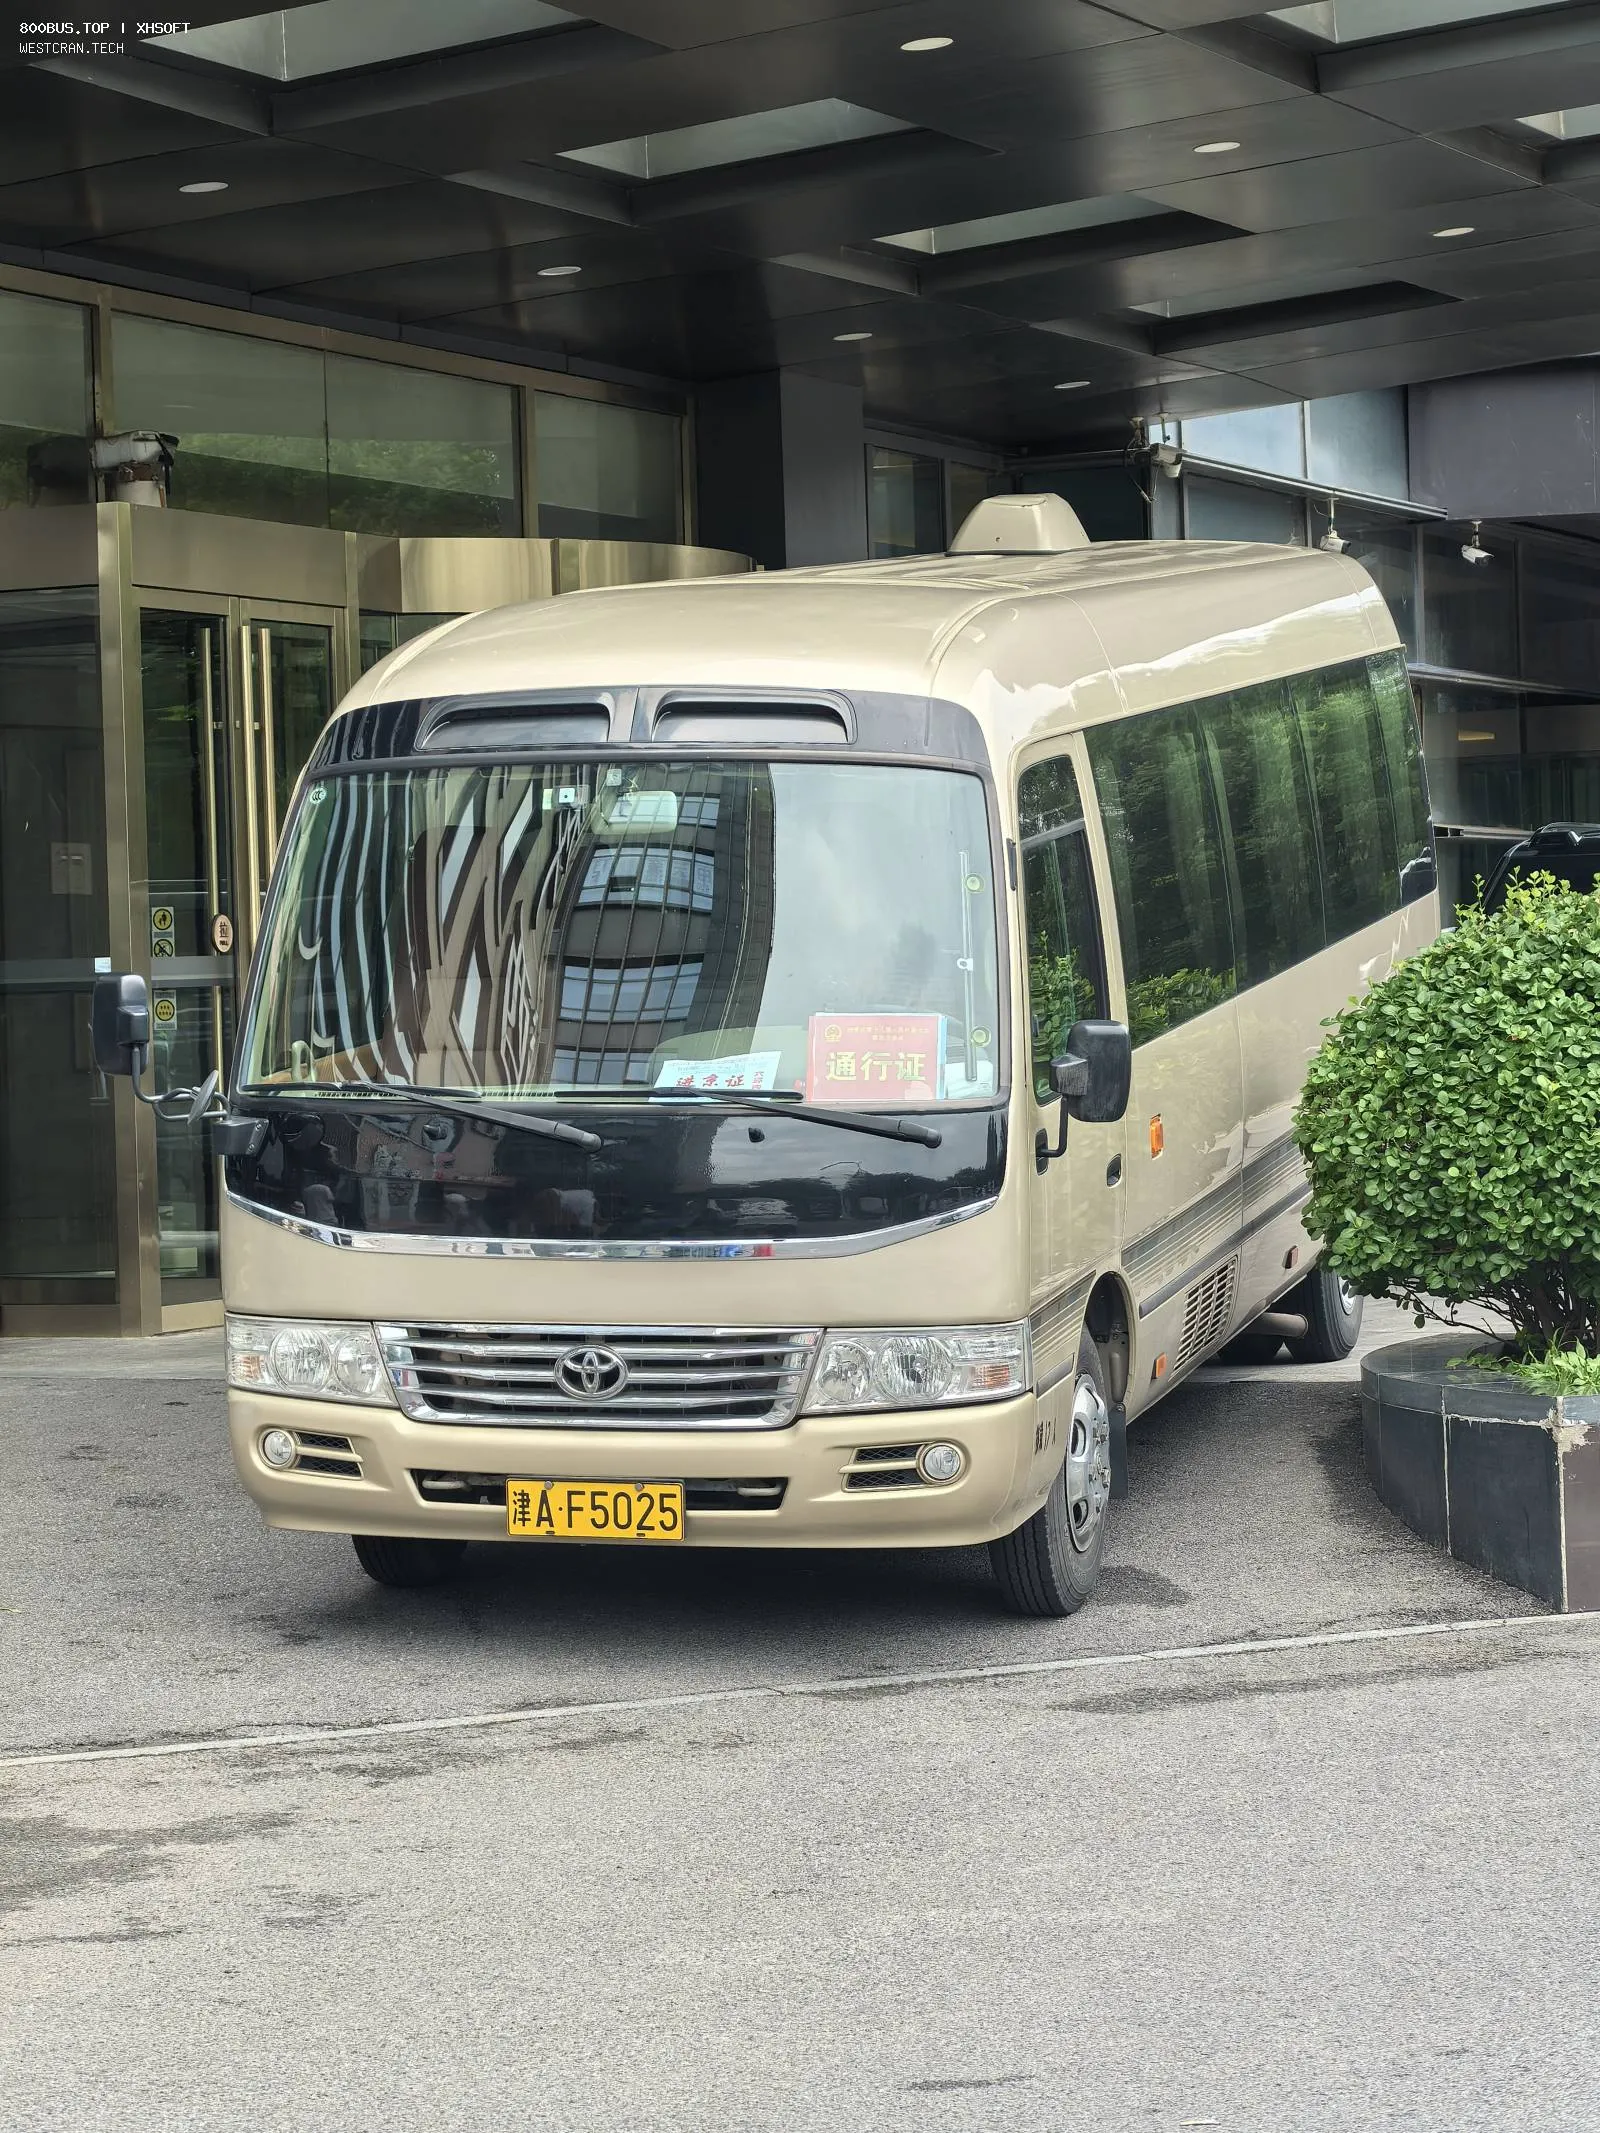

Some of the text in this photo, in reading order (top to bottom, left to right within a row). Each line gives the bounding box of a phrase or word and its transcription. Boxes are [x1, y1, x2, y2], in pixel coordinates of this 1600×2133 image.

[219, 921, 230, 938] 拉
[825, 1051, 926, 1081] 通行证
[676, 1073, 744, 1088] 进京证
[513, 1489, 678, 1531] 津A·F5025
